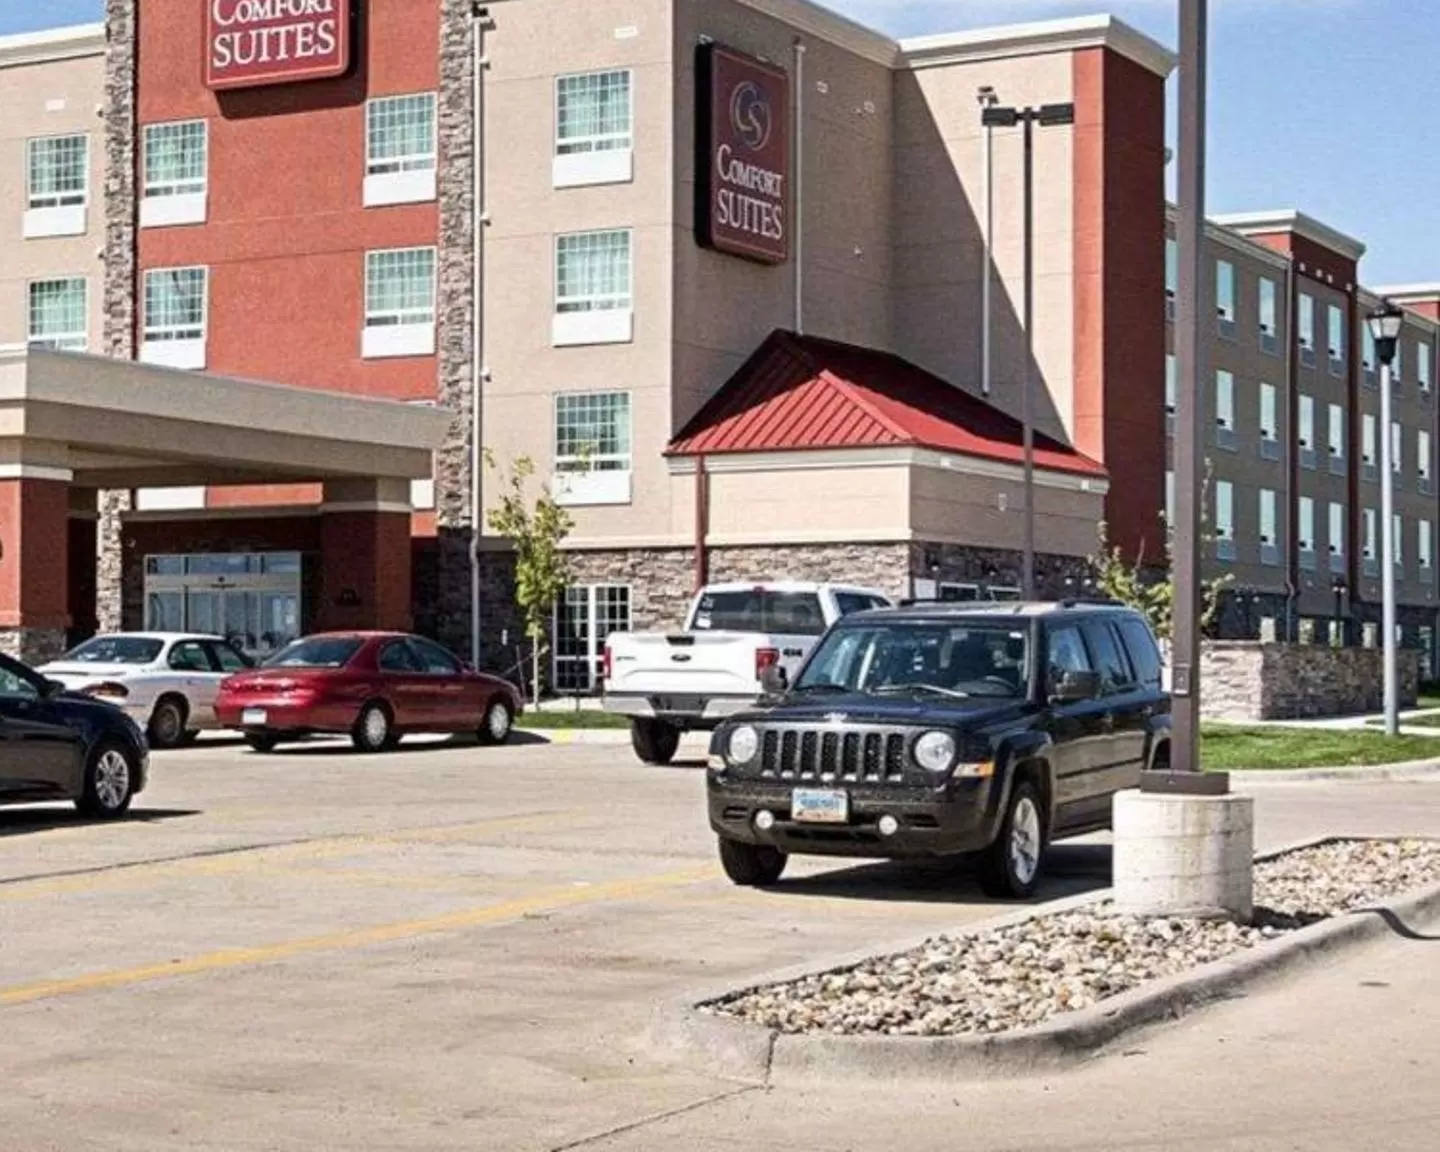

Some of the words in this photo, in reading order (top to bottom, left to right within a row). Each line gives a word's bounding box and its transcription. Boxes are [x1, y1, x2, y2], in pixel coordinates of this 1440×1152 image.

[213, 19, 336, 68] SUITES
[716, 143, 783, 198] COMFORT
[716, 188, 783, 241] SUITES
